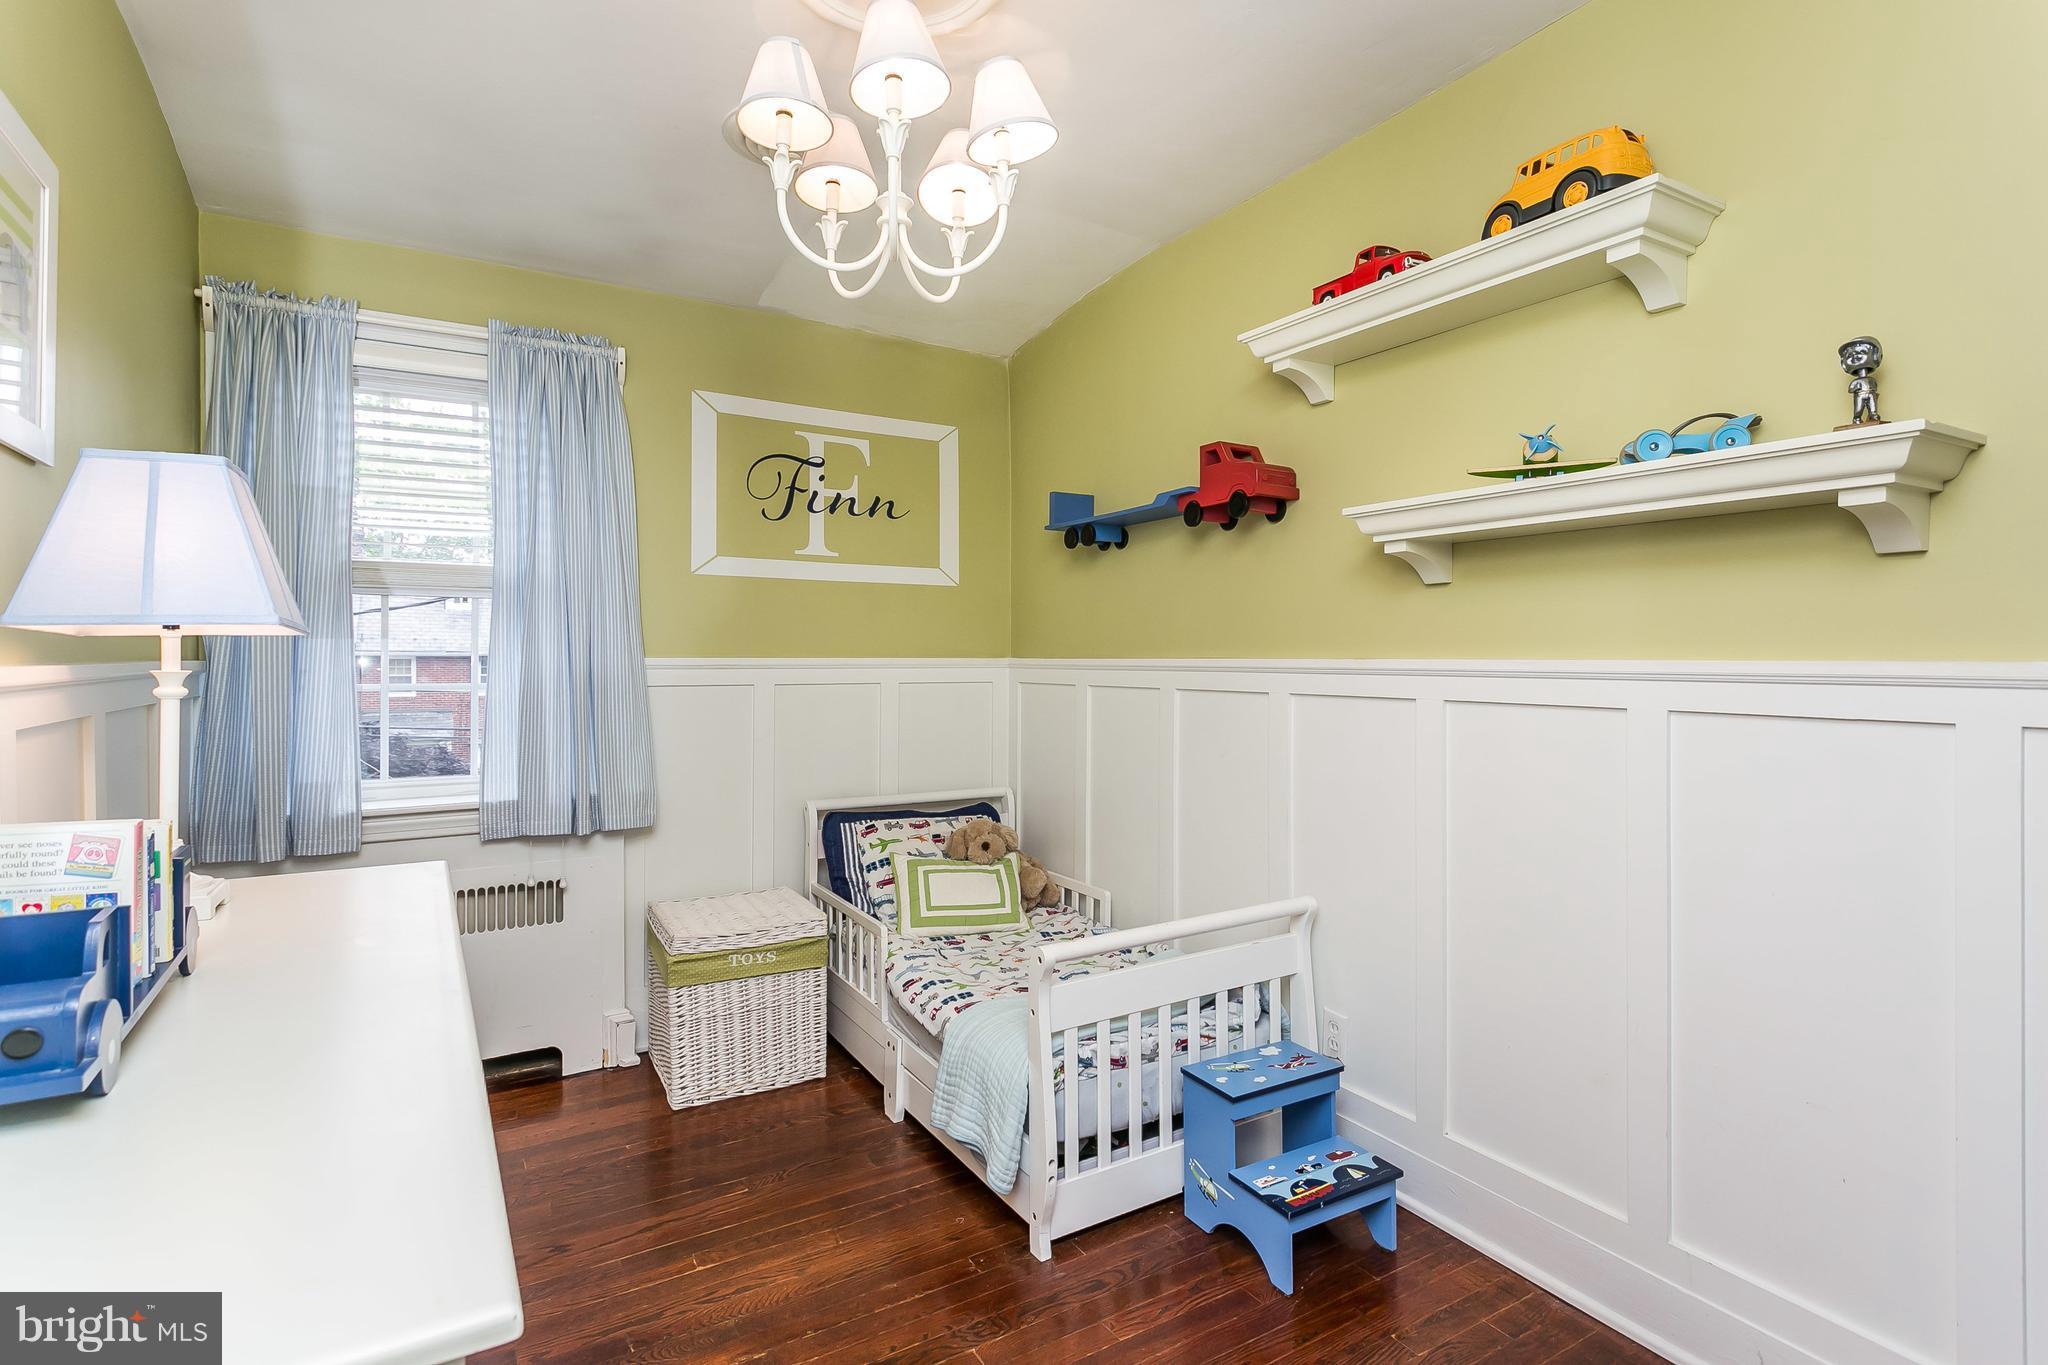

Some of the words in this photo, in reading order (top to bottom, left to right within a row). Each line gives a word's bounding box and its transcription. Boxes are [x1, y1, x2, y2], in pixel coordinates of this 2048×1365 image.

[747, 453, 911, 521] Finn
[795, 430, 870, 557] F
[36, 840, 62, 848] noses
[31, 849, 64, 858] round?
[1, 860, 29, 869] could
[32, 860, 57, 868] these
[16, 870, 28, 878] be
[728, 950, 777, 967] TOYS
